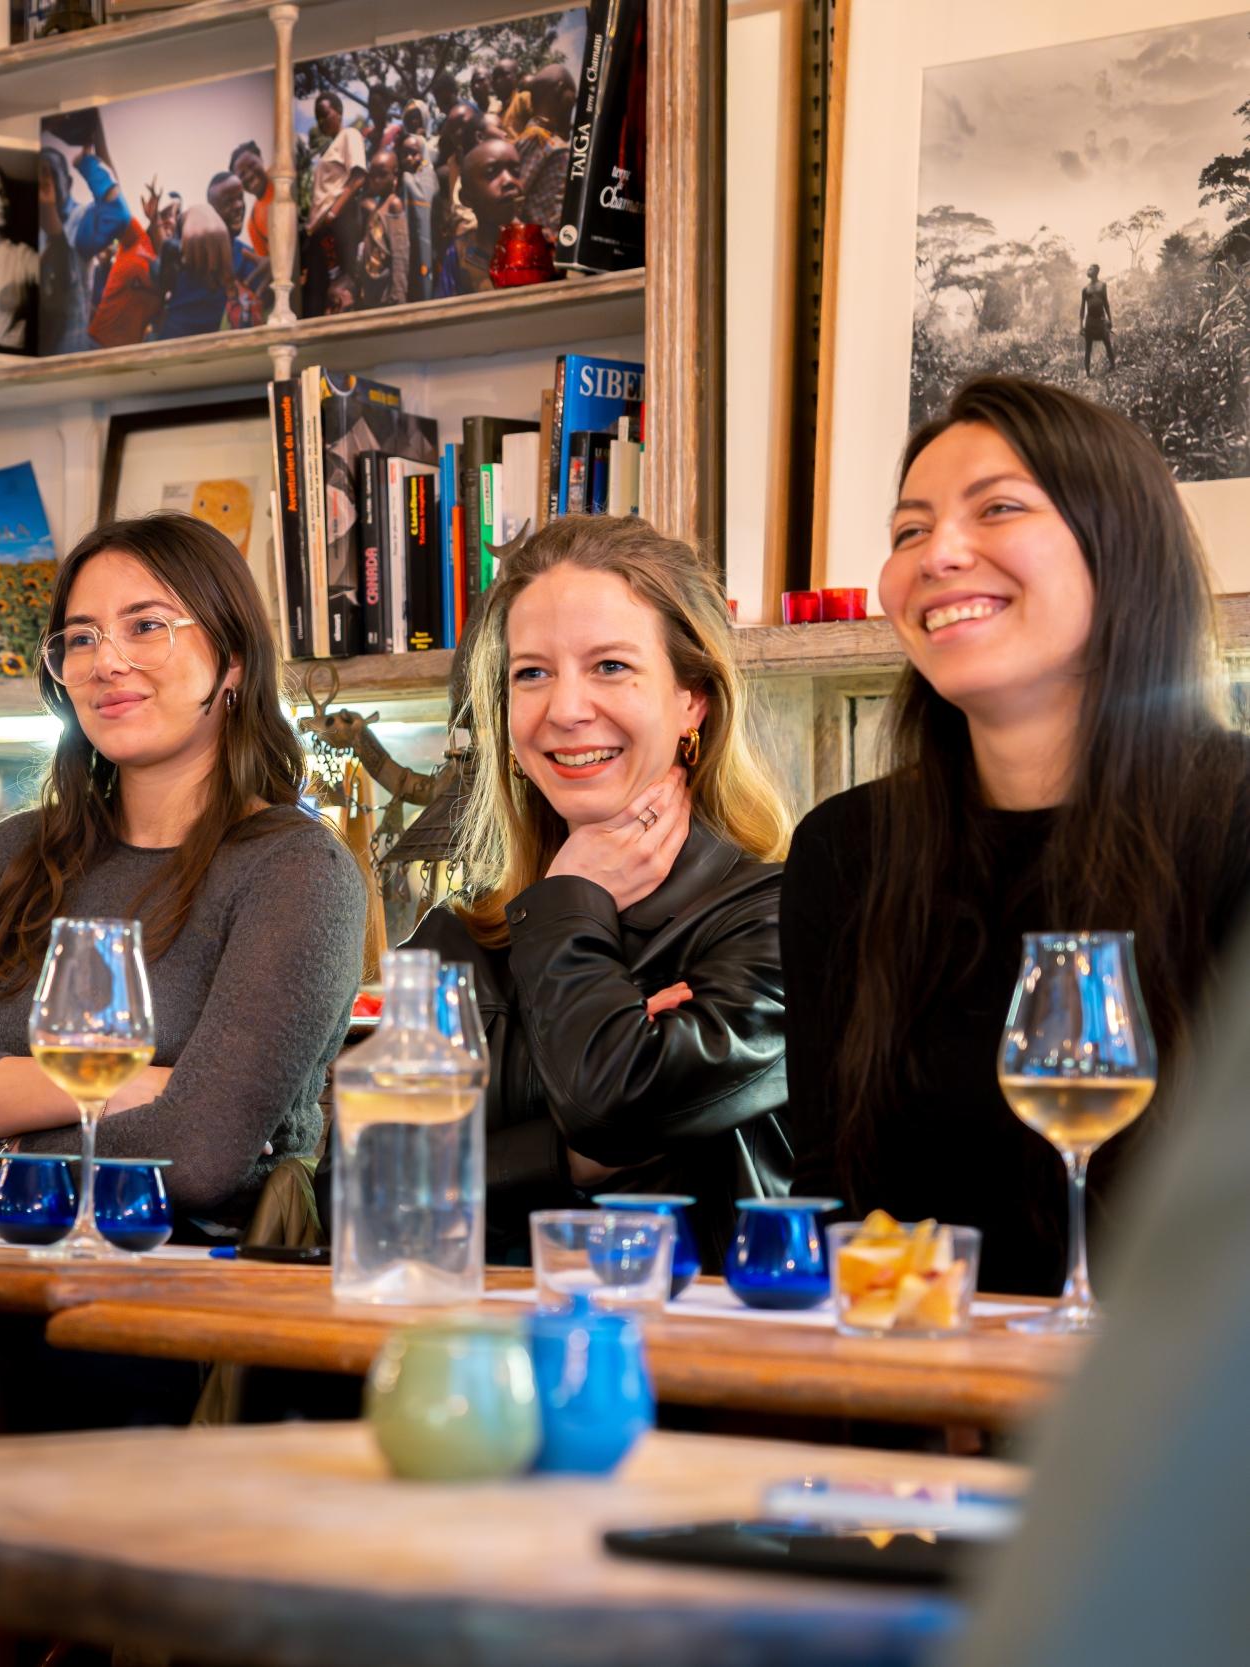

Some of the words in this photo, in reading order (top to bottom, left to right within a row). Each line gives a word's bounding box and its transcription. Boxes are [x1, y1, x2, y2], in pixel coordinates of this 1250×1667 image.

[571, 123, 591, 180] TAIGA
[281, 395, 293, 433] monde
[284, 435, 294, 448] du
[285, 450, 298, 512] Aventuriers
[365, 547, 379, 605] CANADA
